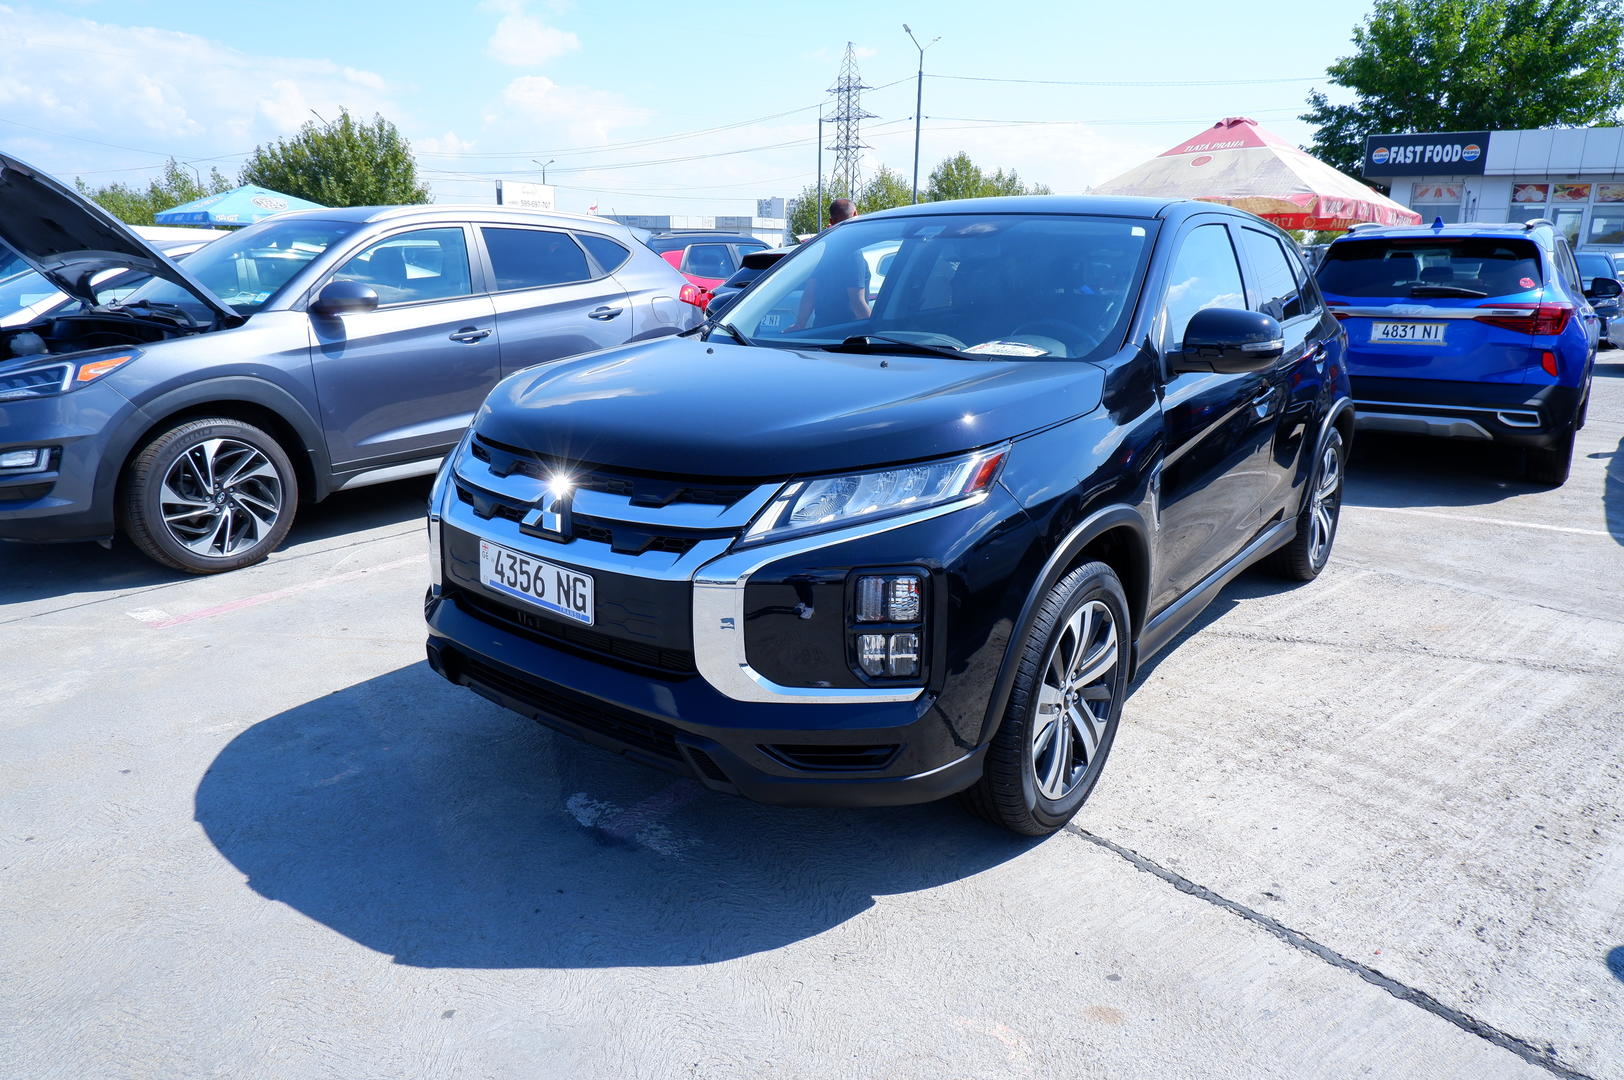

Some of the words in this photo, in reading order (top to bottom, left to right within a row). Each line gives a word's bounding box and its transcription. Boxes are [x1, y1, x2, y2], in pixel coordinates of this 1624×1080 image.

[1211, 140, 1244, 150] PRAHA
[1389, 145, 1424, 164] FAST
[1424, 144, 1462, 163] FOOD
[1382, 324, 1417, 339] 4831
[1422, 325, 1440, 339] NI
[482, 550, 489, 560] GE
[494, 550, 546, 598] 4356
[556, 570, 587, 613] NG
